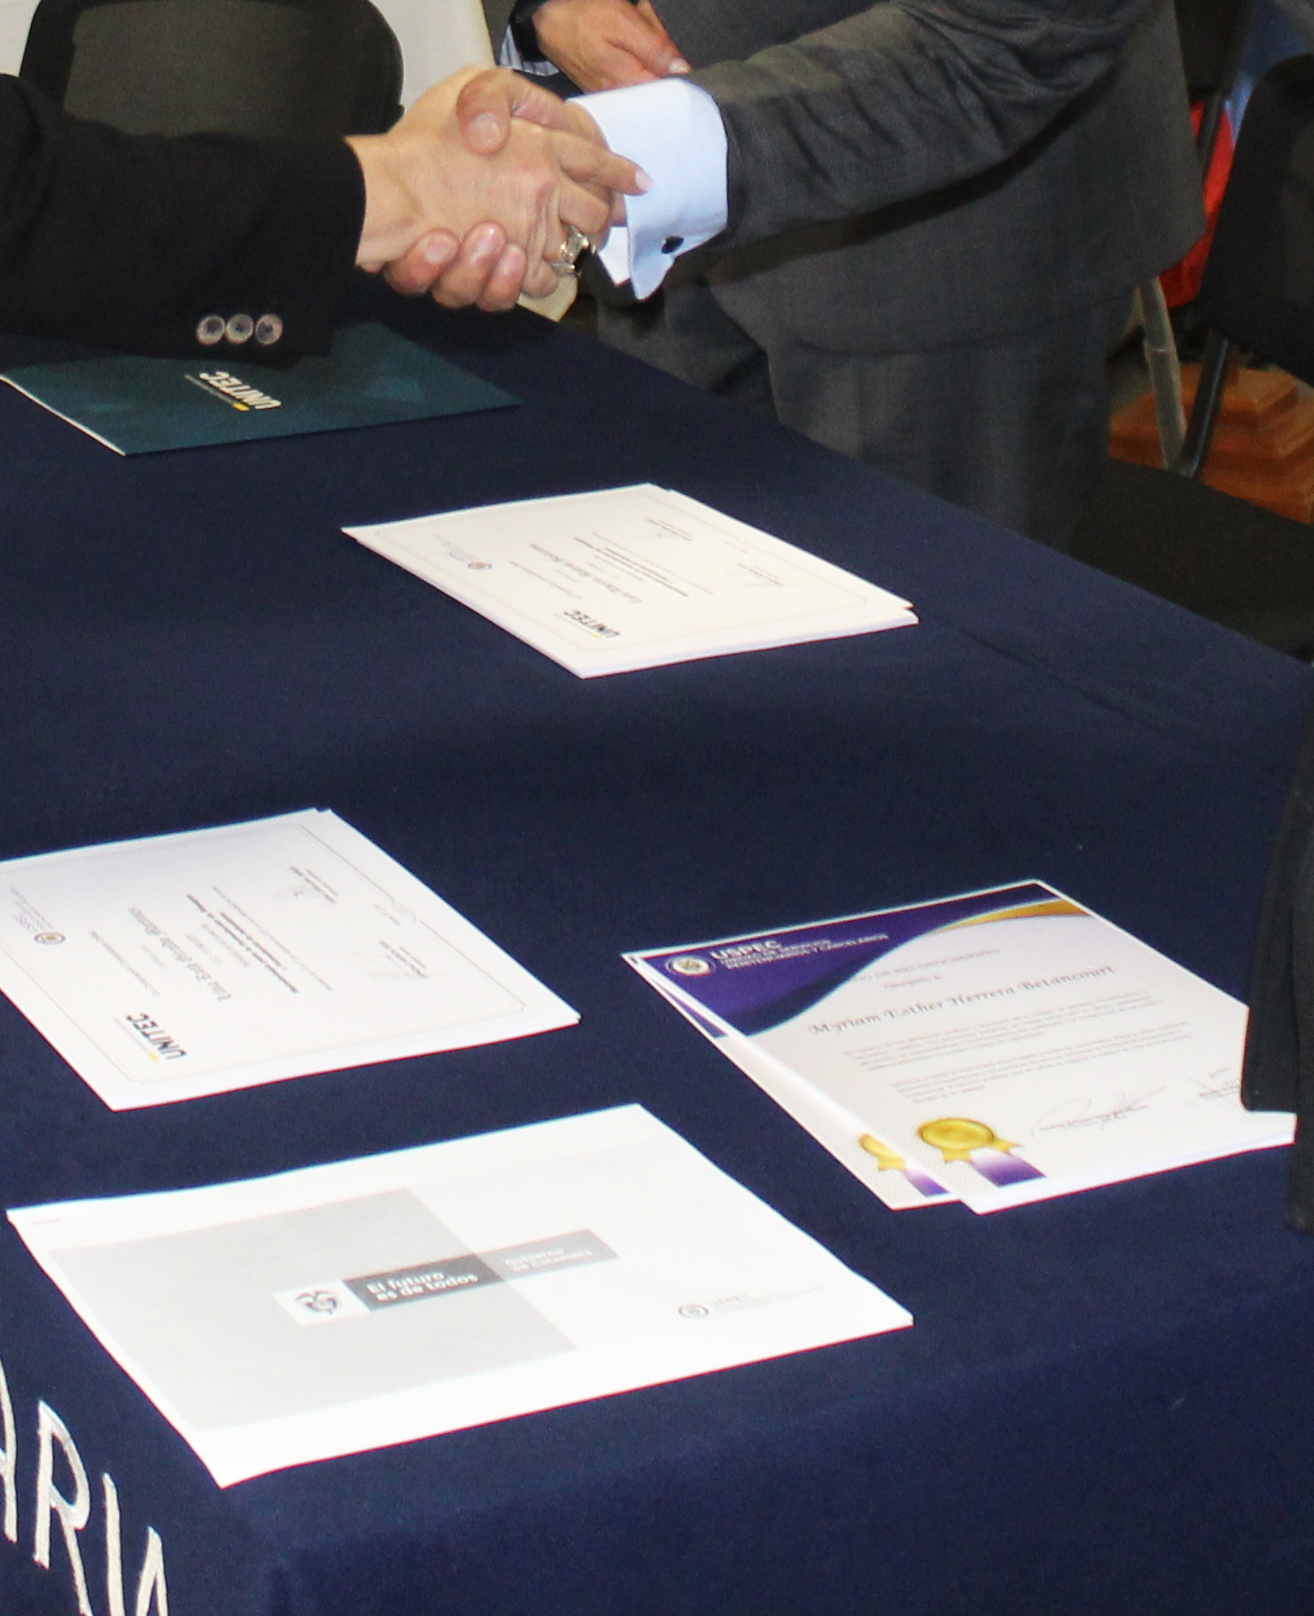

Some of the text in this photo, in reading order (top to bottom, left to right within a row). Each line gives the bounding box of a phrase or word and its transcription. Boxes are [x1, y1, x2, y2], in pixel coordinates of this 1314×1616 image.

[199, 370, 282, 410] UNITEC
[126, 1012, 187, 1060] UNITEC
[388, 1271, 446, 1291] futuro
[400, 1285, 425, 1297] de
[427, 1273, 479, 1292] todos
